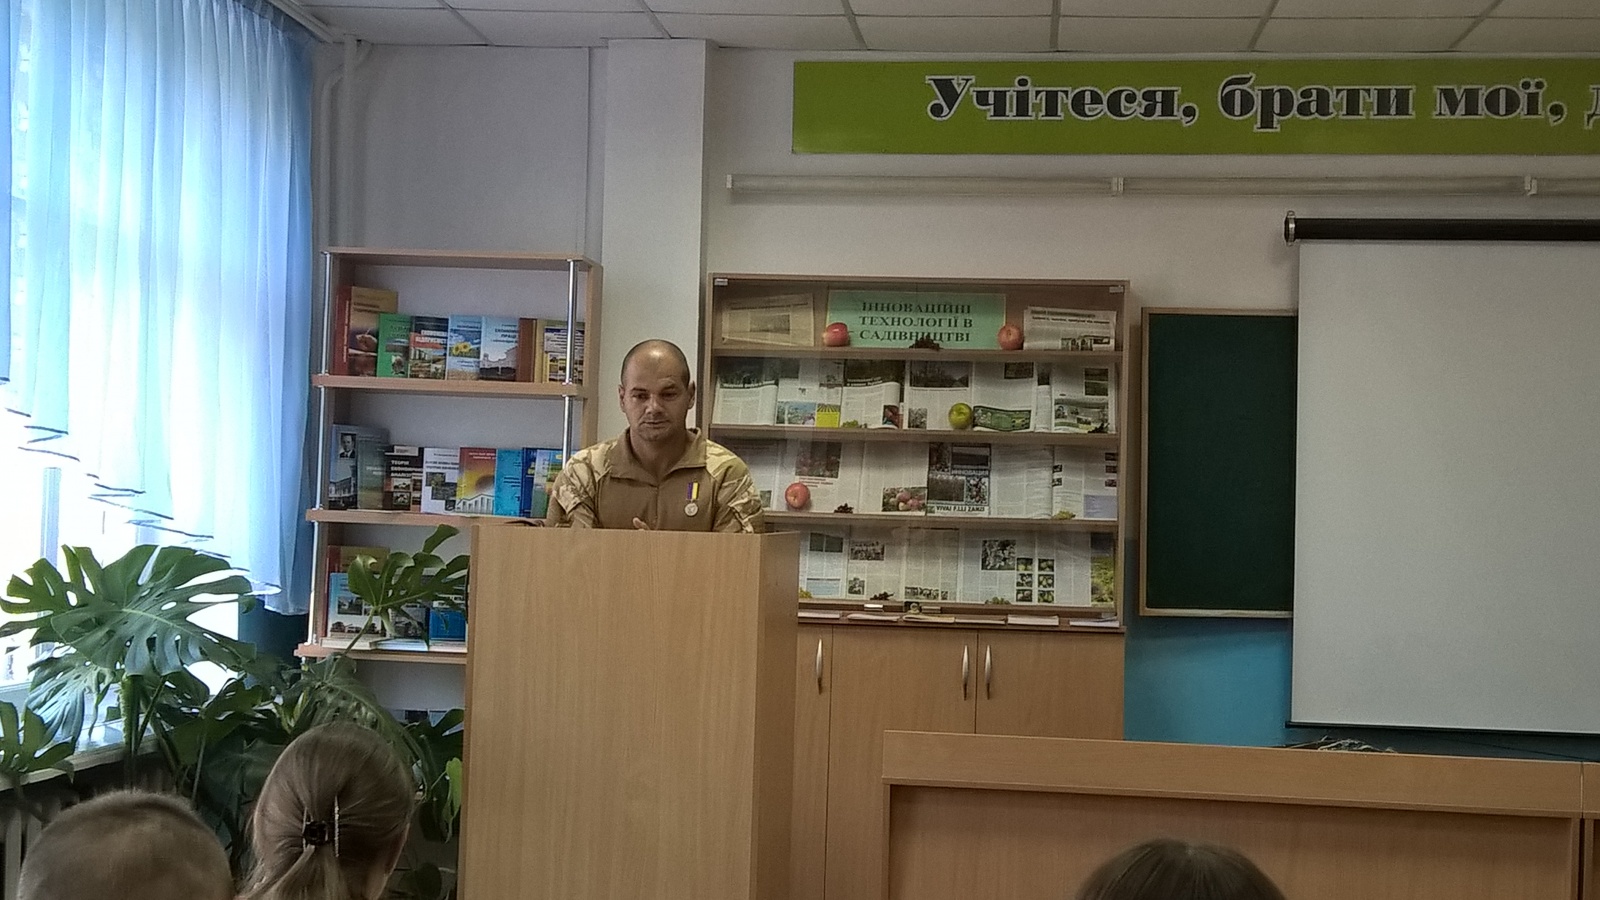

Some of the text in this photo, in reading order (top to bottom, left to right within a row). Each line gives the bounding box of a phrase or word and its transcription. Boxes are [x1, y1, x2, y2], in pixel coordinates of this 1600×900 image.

[926, 75, 1199, 126] Учітеся,
[1217, 72, 1416, 132] брати
[1433, 78, 1568, 127] мої,
[861, 301, 971, 314] ІННОВАЦІЙНІ
[859, 316, 973, 328] ТЕХНОЛОГІЇ В
